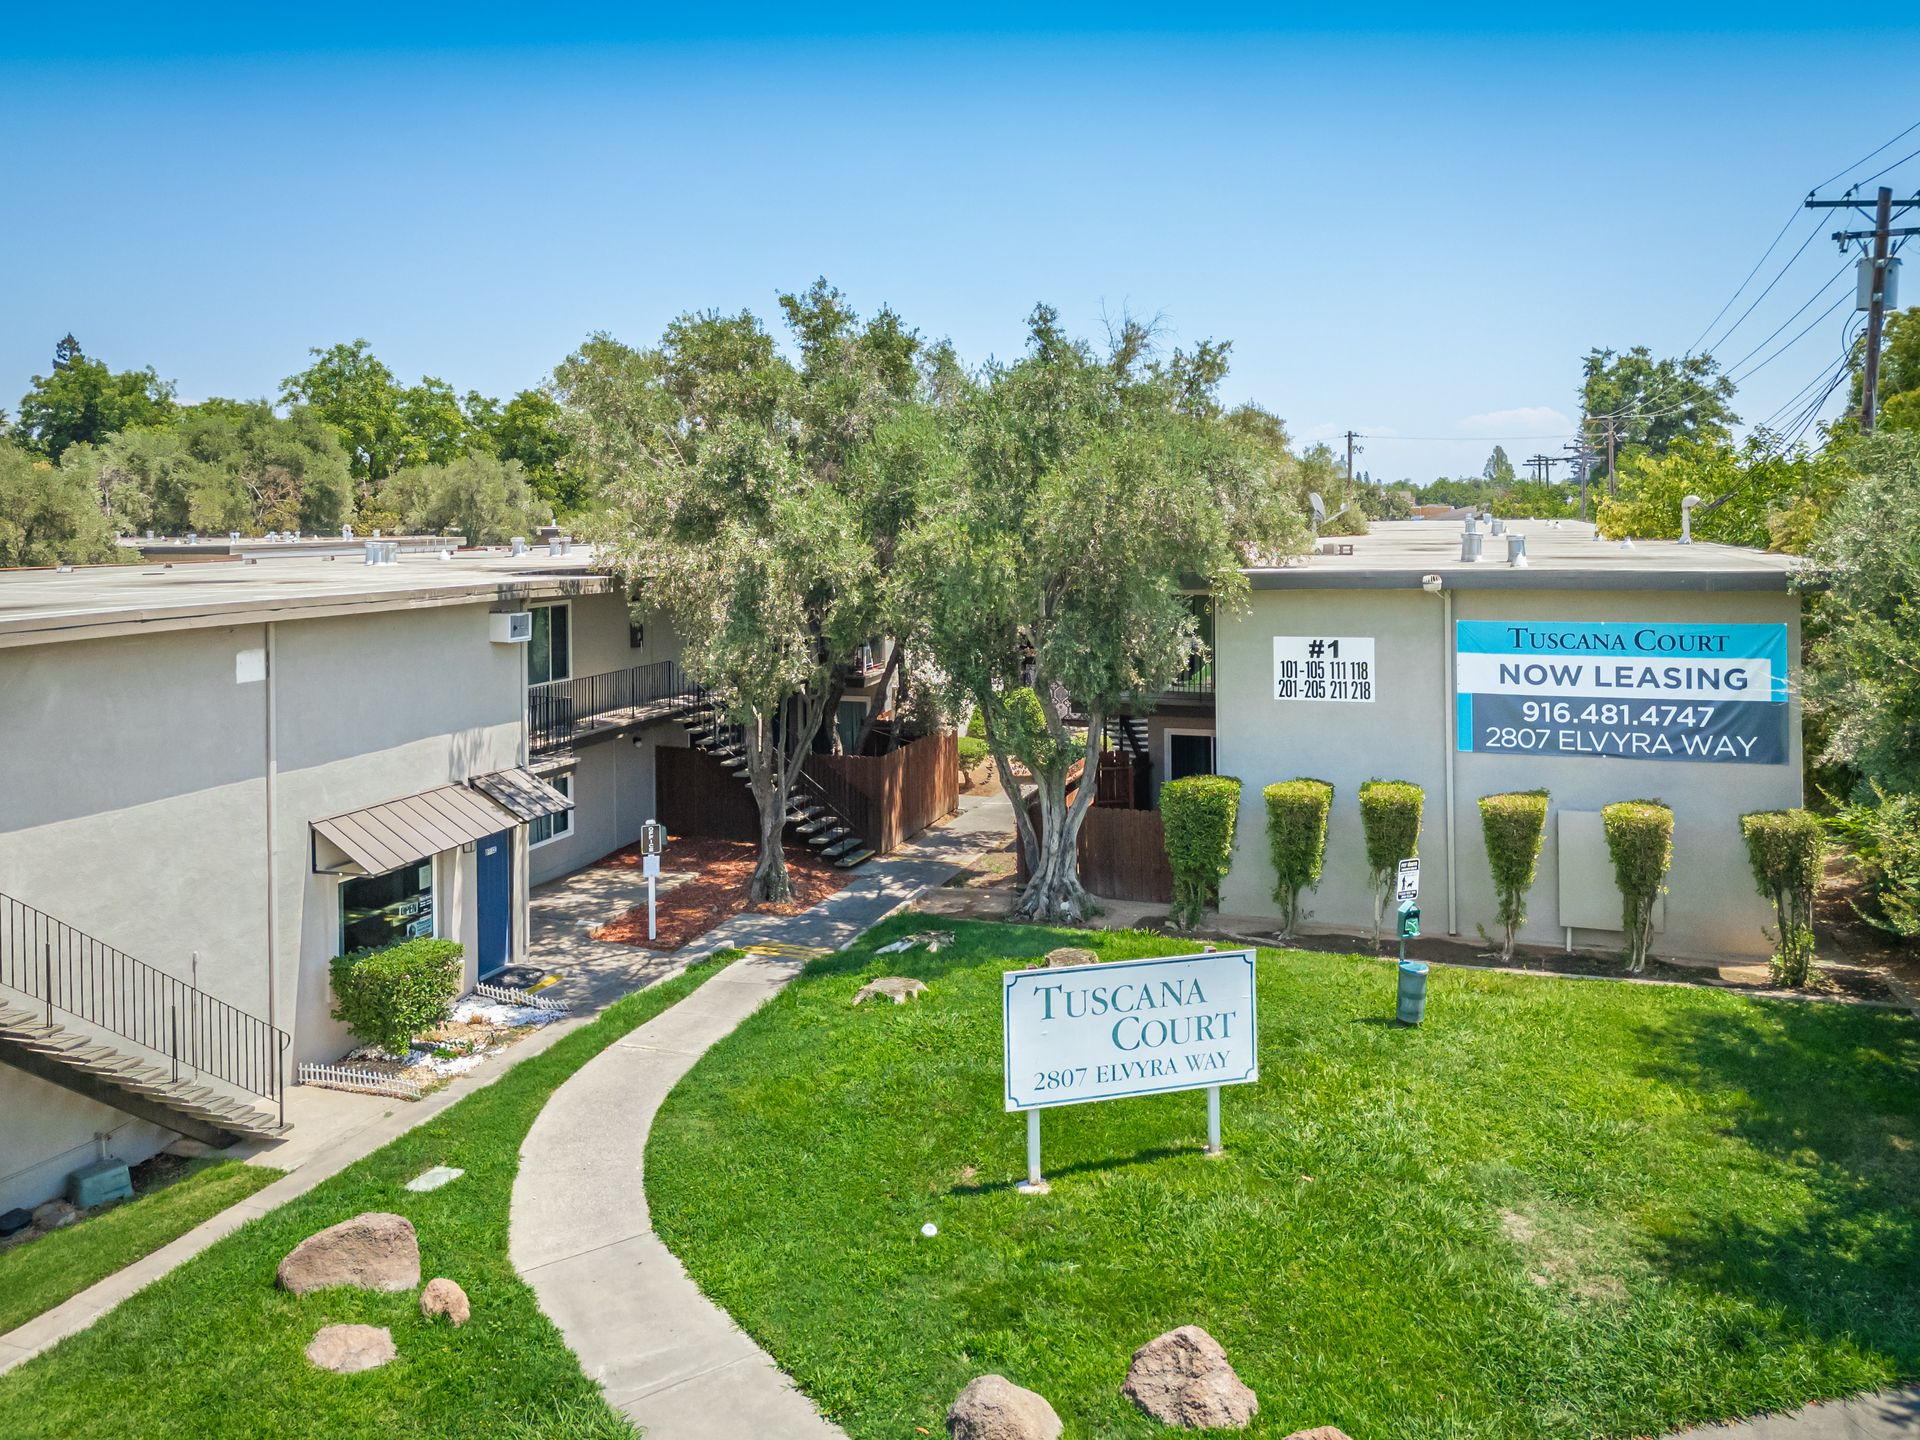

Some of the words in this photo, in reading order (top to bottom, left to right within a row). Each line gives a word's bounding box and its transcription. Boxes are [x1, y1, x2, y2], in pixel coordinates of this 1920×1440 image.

[1309, 640, 1339, 659] #1
[1507, 627, 1626, 651] TUSCANA
[1633, 629, 1730, 652] COURT
[1280, 660, 1325, 679] 101-105
[1330, 661, 1346, 680] 111
[1350, 661, 1368, 680] 118
[1500, 663, 1583, 687] NOW
[1595, 666, 1748, 691] LEASING
[1278, 679, 1326, 699] 201-205
[1330, 680, 1348, 699] 211
[1351, 681, 1371, 700] 218
[1523, 701, 1715, 728] 916.481.4747
[1486, 727, 1551, 750] 2807
[1559, 730, 1673, 755] ELVYRA
[1681, 734, 1758, 757] WAY
[1033, 977, 1209, 1021] TUSCANA
[1111, 1011, 1237, 1051] COURT
[1033, 1067, 1088, 1091] 2807
[1096, 1057, 1179, 1084] ELVYRA
[1184, 1050, 1231, 1074] WAY
